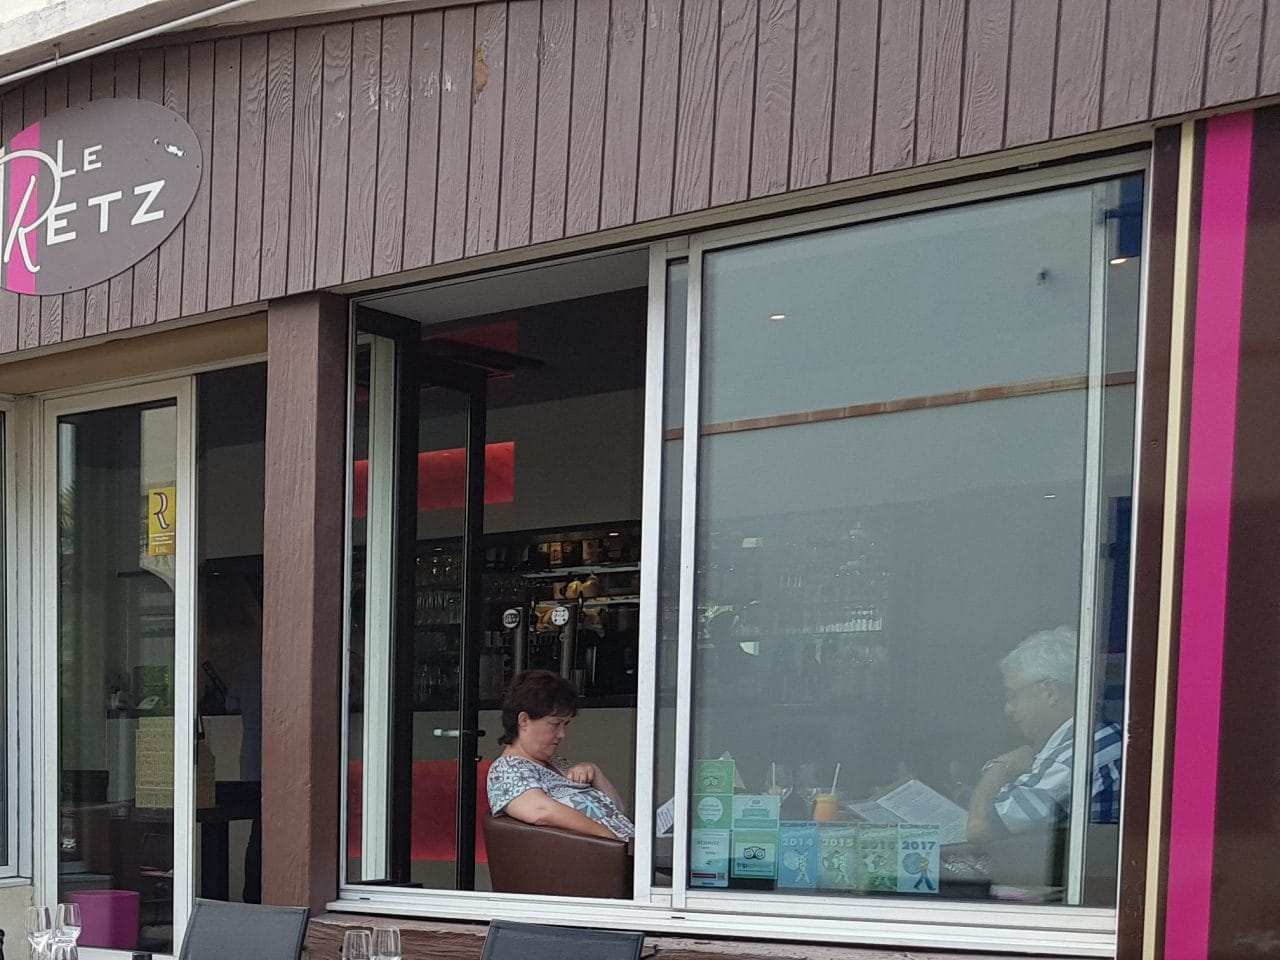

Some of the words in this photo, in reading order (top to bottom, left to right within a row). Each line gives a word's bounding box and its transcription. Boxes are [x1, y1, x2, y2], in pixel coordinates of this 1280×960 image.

[57, 138, 103, 178] LE
[782, 838, 814, 847] 2014
[822, 838, 854, 847] 2015
[901, 840, 936, 851] 2017
